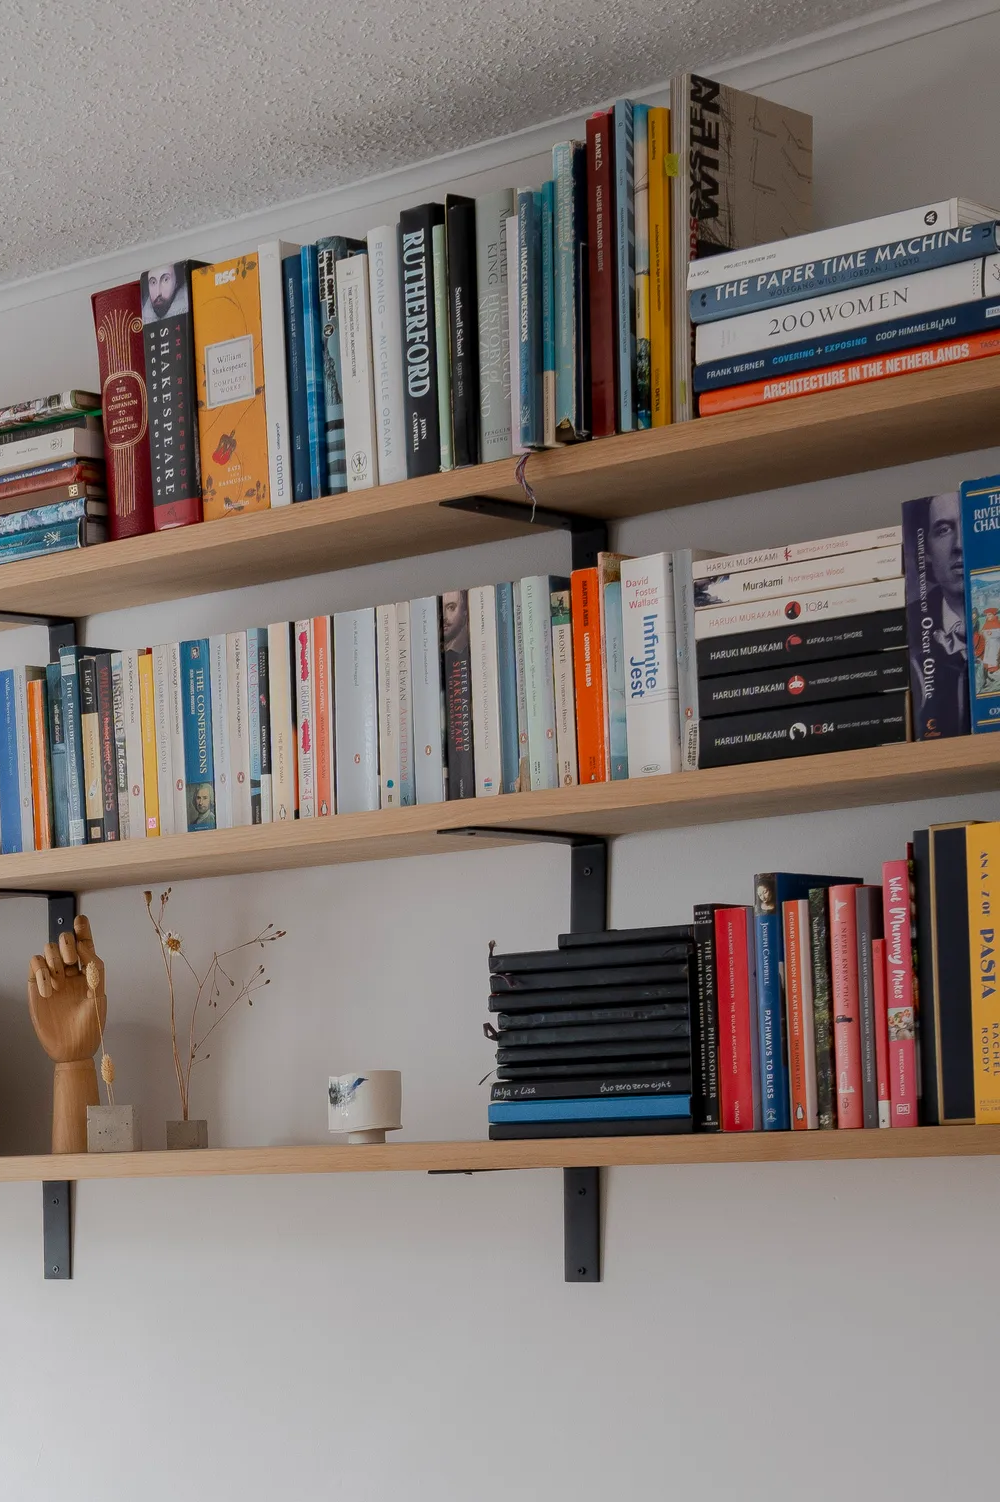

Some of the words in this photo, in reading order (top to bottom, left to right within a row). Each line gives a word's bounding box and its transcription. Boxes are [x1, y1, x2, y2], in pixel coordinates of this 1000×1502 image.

[698, 80, 720, 220] WIEN
[324, 249, 334, 277] FROM
[374, 241, 386, 315] BECOMING
[488, 243, 498, 285] KING
[715, 280, 748, 301] THE
[757, 263, 815, 291] PAPER
[822, 250, 867, 276] TIME
[875, 225, 973, 263] MACHINE
[769, 281, 814, 298] WOLFGANG
[818, 276, 837, 286] WILD
[849, 268, 881, 279] JORDAN
[894, 257, 920, 268] LLOYD
[326, 278, 336, 320] CONTROL
[402, 230, 430, 398] RUTHERFORD
[454, 287, 462, 328] Southwell
[456, 328, 464, 357] School
[488, 293, 501, 367] HISTORY
[875, 330, 897, 342] COOP
[217, 352, 242, 364] William
[772, 348, 814, 365] COVERING
[824, 336, 867, 354] EXPOSING
[212, 361, 247, 375] Shakespeare
[379, 335, 390, 401] MICHELLE
[707, 367, 731, 380] FRANK
[733, 359, 765, 374] WERNER
[763, 368, 845, 400] ARCHITECTURE
[848, 366, 861, 381] IN
[861, 359, 883, 379] THE
[886, 343, 969, 374] NETHERLANDS
[108, 400, 138, 411] COMPANION
[112, 393, 132, 402] OXFORD
[149, 332, 158, 404] SECOND
[154, 419, 162, 496] EDITION
[159, 327, 175, 495] SHAKESPEARE
[176, 376, 187, 491] RIVERSIDE
[382, 407, 392, 457] OBAMA
[419, 418, 427, 439] JOHN
[218, 475, 252, 487] RASMUSSEN
[706, 559, 735, 573] HARUKI
[736, 552, 778, 567] MURAKAMI
[796, 545, 824, 556] BIRTHDAY
[825, 540, 849, 551] STORIES
[917, 528, 926, 571] COMPLETE
[625, 576, 649, 588] David
[635, 586, 658, 598] Foster
[742, 575, 783, 592] Murakami
[787, 572, 824, 585] Norwegian
[826, 566, 846, 578] Wood
[918, 572, 927, 600] WORKS
[628, 597, 659, 610] Wallace
[708, 617, 737, 628] HARUKI
[738, 609, 780, 623] MURAKAMI
[804, 600, 829, 612] 1Q84
[710, 649, 739, 661] HARUKI
[740, 641, 784, 656] MURAKAMI
[806, 636, 825, 645] KAFKA
[843, 631, 864, 640] SHORE
[921, 616, 934, 653] Oscar
[643, 614, 659, 690] Infinite
[84, 669, 93, 686] Life
[196, 668, 204, 692] THE
[460, 660, 469, 694] PETER
[630, 656, 645, 699] Jest
[712, 688, 742, 701] HARUKI
[742, 682, 785, 696] MURAKAMI
[850, 670, 878, 680] CHRONICLE
[923, 658, 935, 699] Wilde
[112, 673, 123, 735] DISGRACE
[301, 685, 310, 718] CREATIVE
[452, 661, 463, 752] SHAKESPEARE
[198, 694, 207, 774] CONFESSIONS
[462, 698, 470, 752] ACKROYD
[714, 735, 743, 747] HARUKI
[744, 729, 787, 742] MURAKAMI
[810, 722, 835, 735] 1Q84
[400, 706, 409, 782] AMSTERDAM
[980, 850, 988, 869] AN
[888, 876, 904, 903] What
[760, 922, 770, 948] JOSEPH
[812, 916, 820, 944] National
[888, 907, 906, 964] Mummy
[704, 940, 712, 961] THE
[762, 948, 771, 986] CAMPBELL
[980, 928, 998, 999] PASTA
[705, 964, 714, 996] MONK
[814, 962, 822, 998] Handbook
[892, 969, 906, 999] Makes
[764, 1009, 774, 1056] PATHWAYS
[707, 1026, 716, 1099] PHILOSOPHER
[982, 1027, 990, 1074] RODDY
[520, 1087, 536, 1095] Lisa
[650, 1080, 672, 1090] eight
[766, 1073, 774, 1099] BLISS
